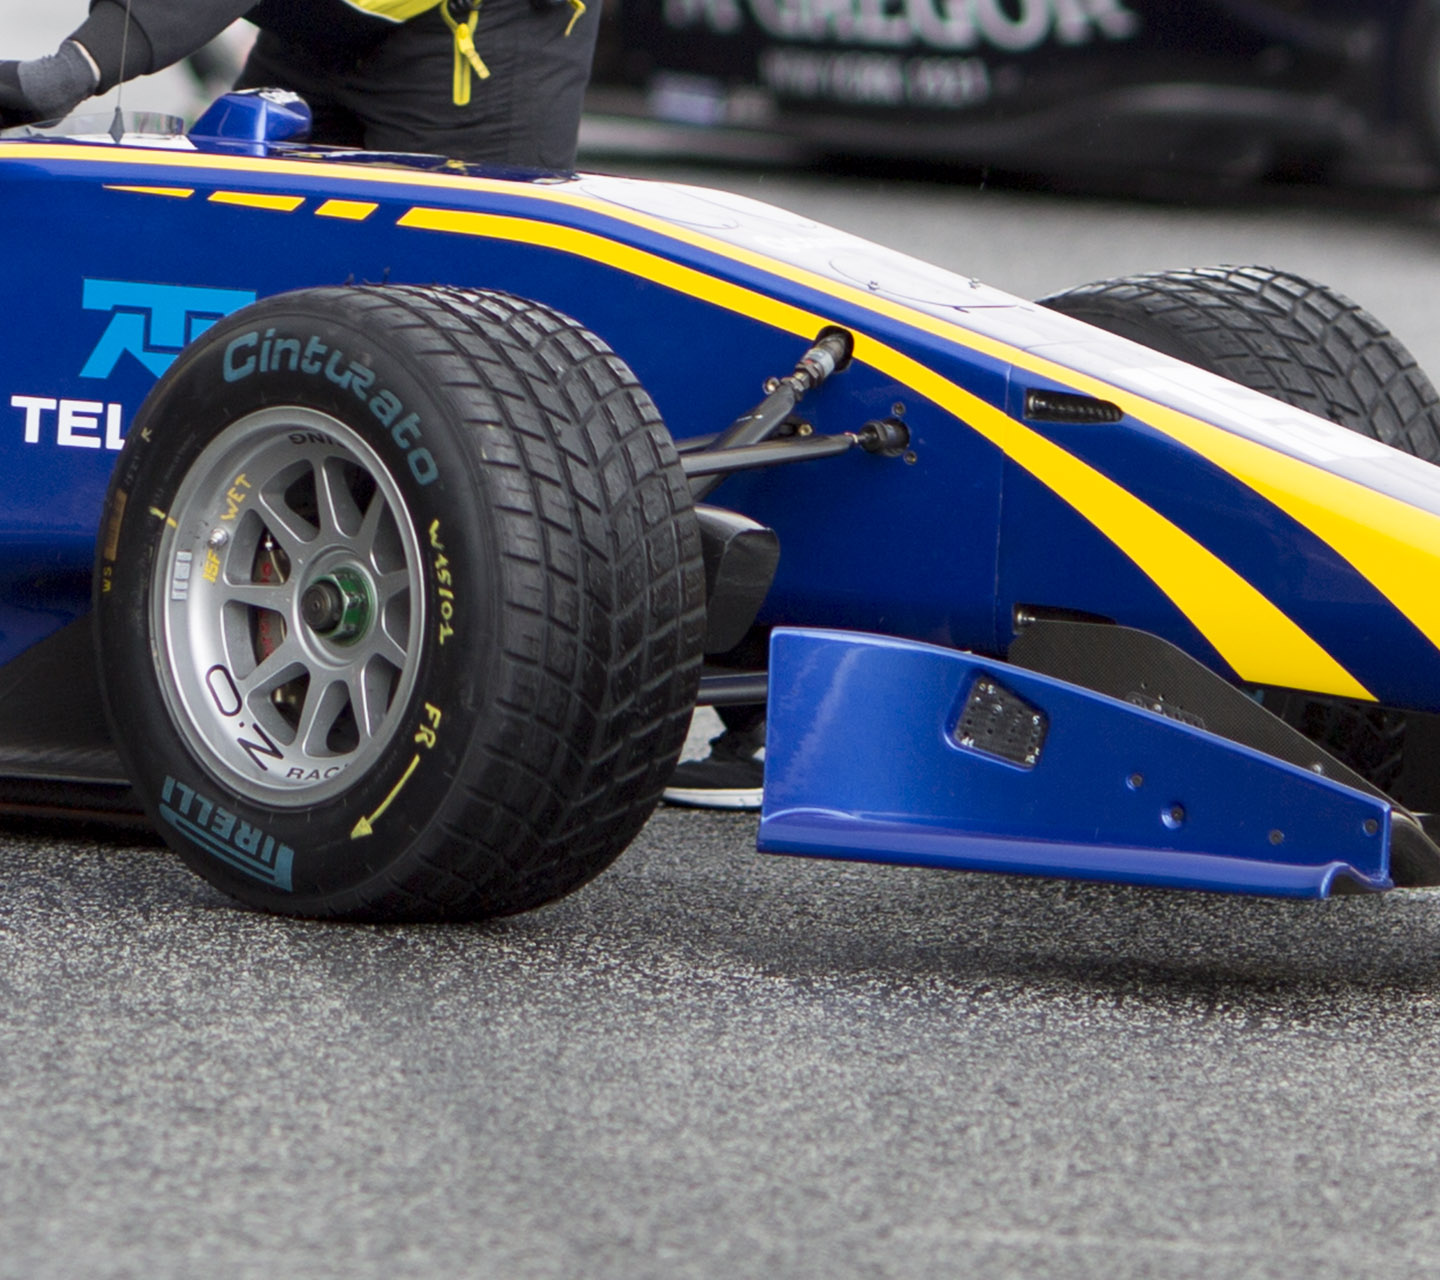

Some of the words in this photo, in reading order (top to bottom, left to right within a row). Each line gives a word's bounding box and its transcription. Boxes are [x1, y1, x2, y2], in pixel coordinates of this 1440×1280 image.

[10, 394, 126, 451] TEL
[220, 472, 253, 522] WET
[413, 701, 443, 750] FR
[158, 775, 296, 893] PIRELLI
